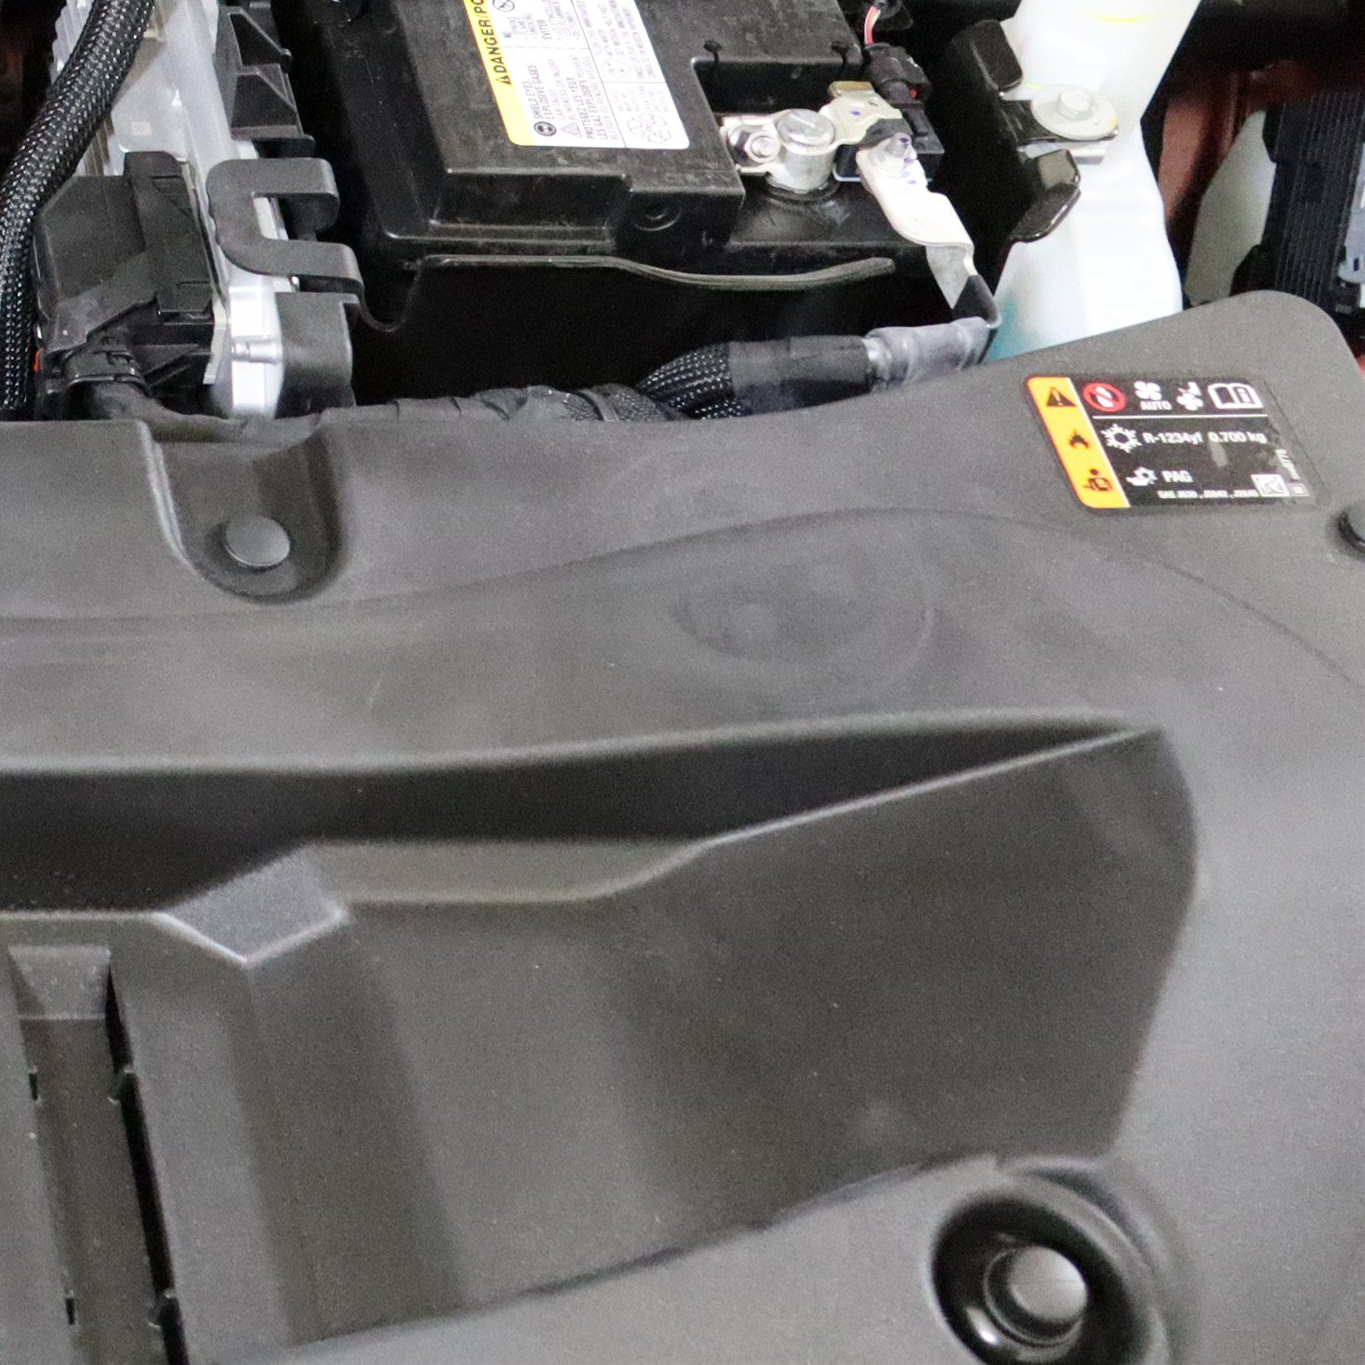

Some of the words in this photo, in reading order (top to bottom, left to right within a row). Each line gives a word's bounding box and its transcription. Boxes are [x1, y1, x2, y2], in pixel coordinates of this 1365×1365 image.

[1141, 400, 1172, 411] AUTO
[1143, 432, 1204, 445] R-1234yf
[1208, 431, 1246, 444] 0.700
[1247, 431, 1268, 445] kg
[1161, 471, 1193, 483] PAG
